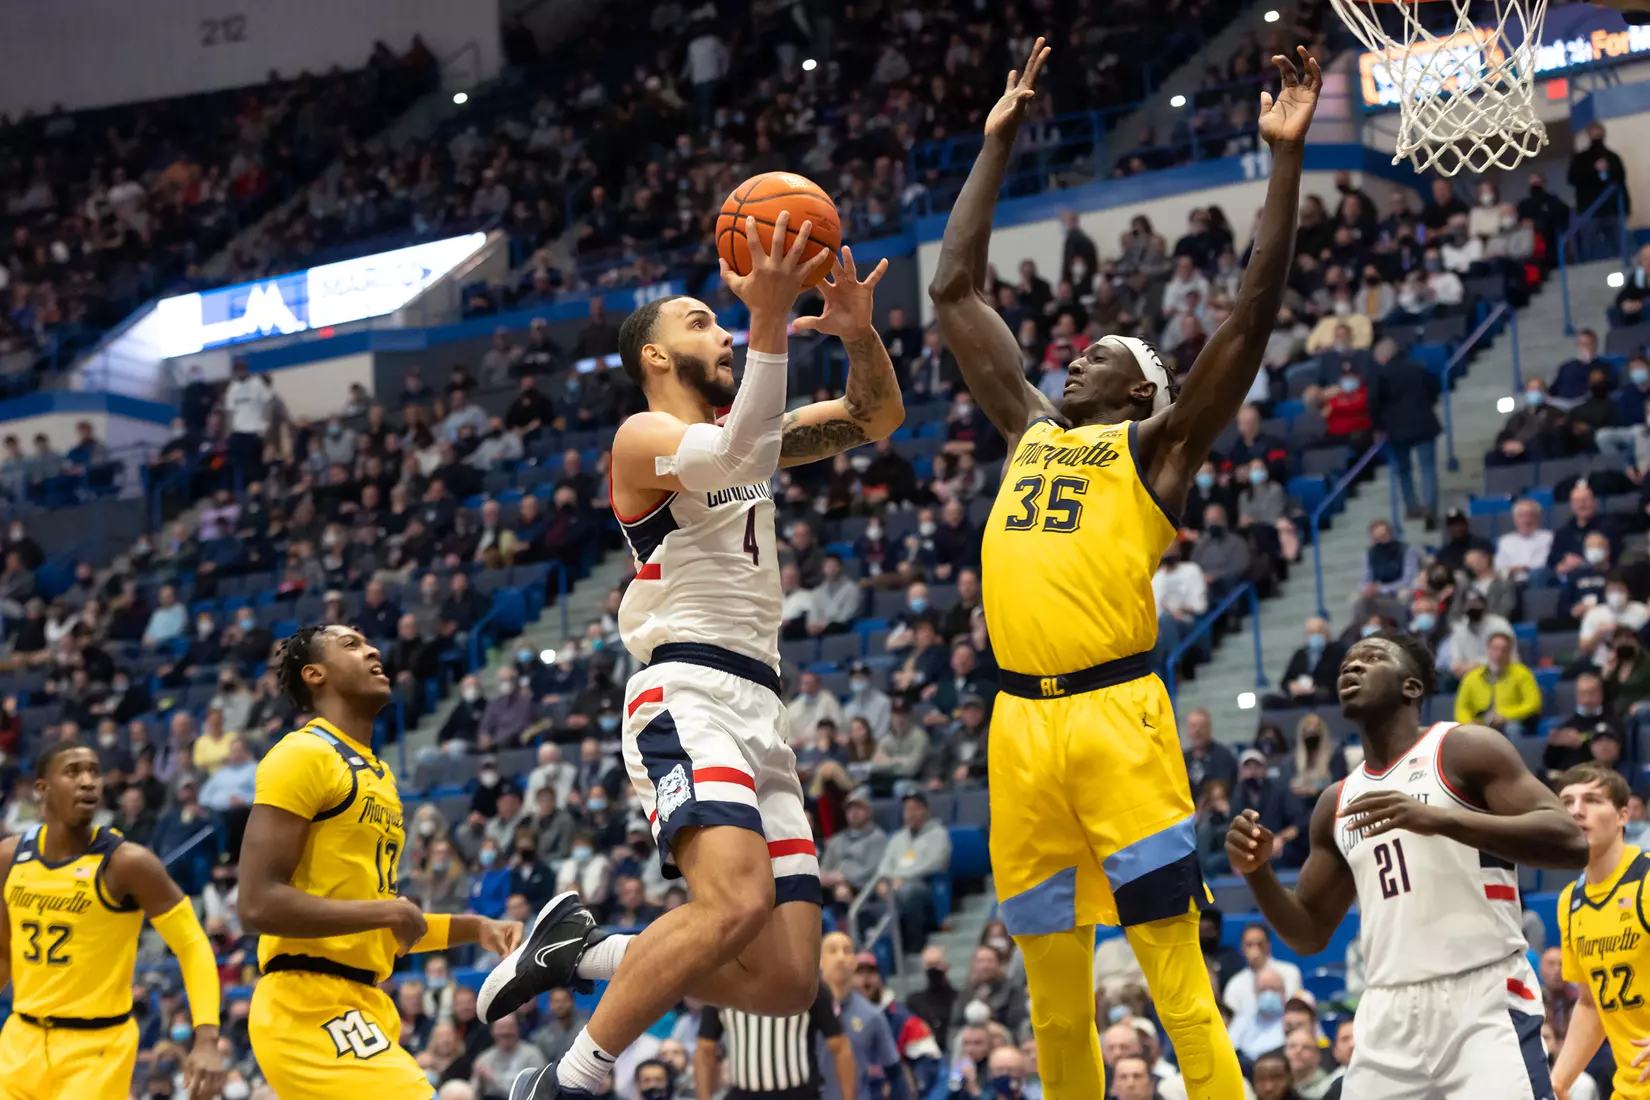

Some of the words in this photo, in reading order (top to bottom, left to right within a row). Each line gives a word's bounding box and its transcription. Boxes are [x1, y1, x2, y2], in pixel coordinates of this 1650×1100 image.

[1014, 441, 1120, 470] Marquette
[1005, 474, 1090, 534] 35
[743, 504, 760, 567] 4
[375, 835, 399, 894] 12
[1373, 837, 1412, 900] 21
[9, 885, 92, 916] Marquette
[21, 920, 74, 967] 32
[1575, 927, 1641, 961] Marquette
[1590, 963, 1645, 1013] 22
[320, 1009, 391, 1060] MU
